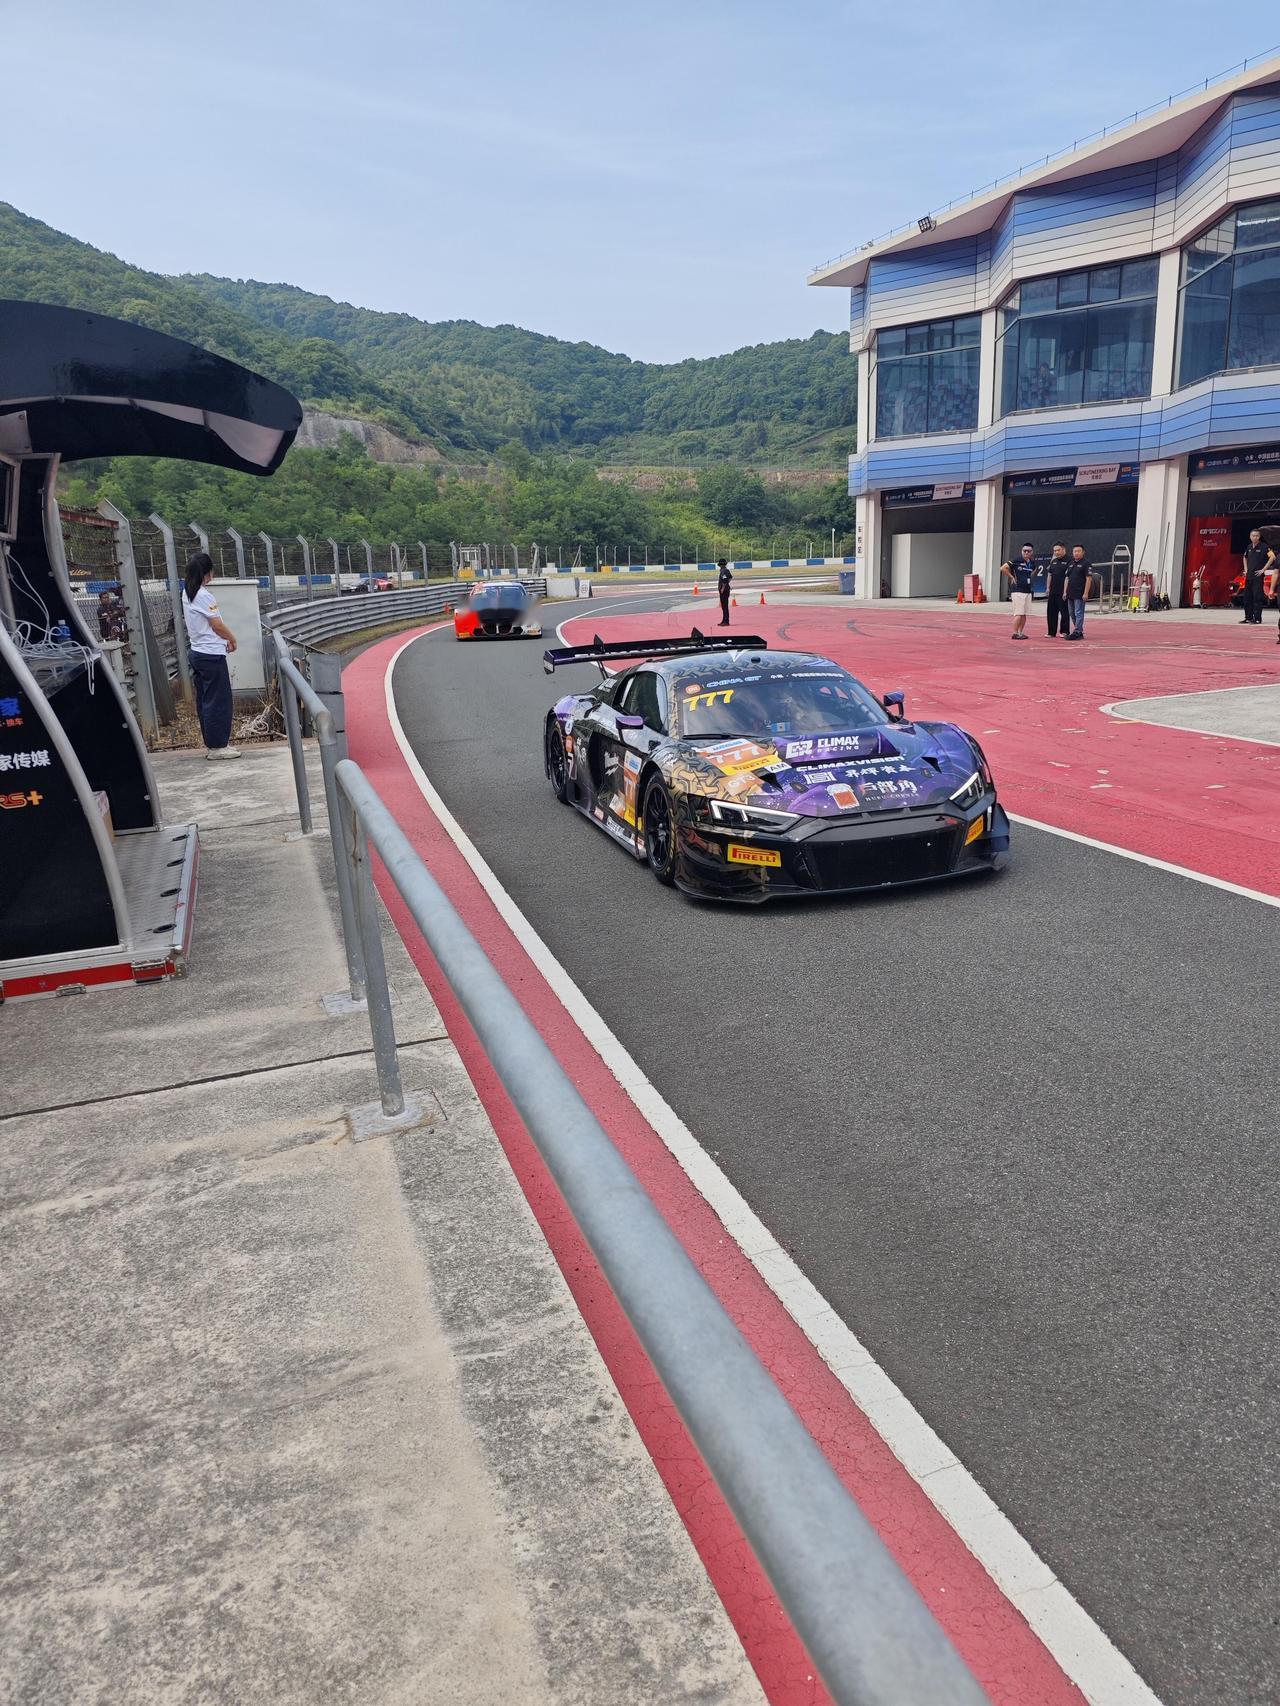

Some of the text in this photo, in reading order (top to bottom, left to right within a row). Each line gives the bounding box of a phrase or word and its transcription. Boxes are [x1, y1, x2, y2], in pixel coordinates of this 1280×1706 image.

[706, 675, 762, 688] CHINA GT
[683, 689, 734, 711] 777
[817, 736, 859, 748] CLIMAX
[706, 745, 761, 764] 777
[817, 745, 859, 753] RACING
[769, 763, 788, 772] AM
[732, 847, 777, 863] PIRELLI
